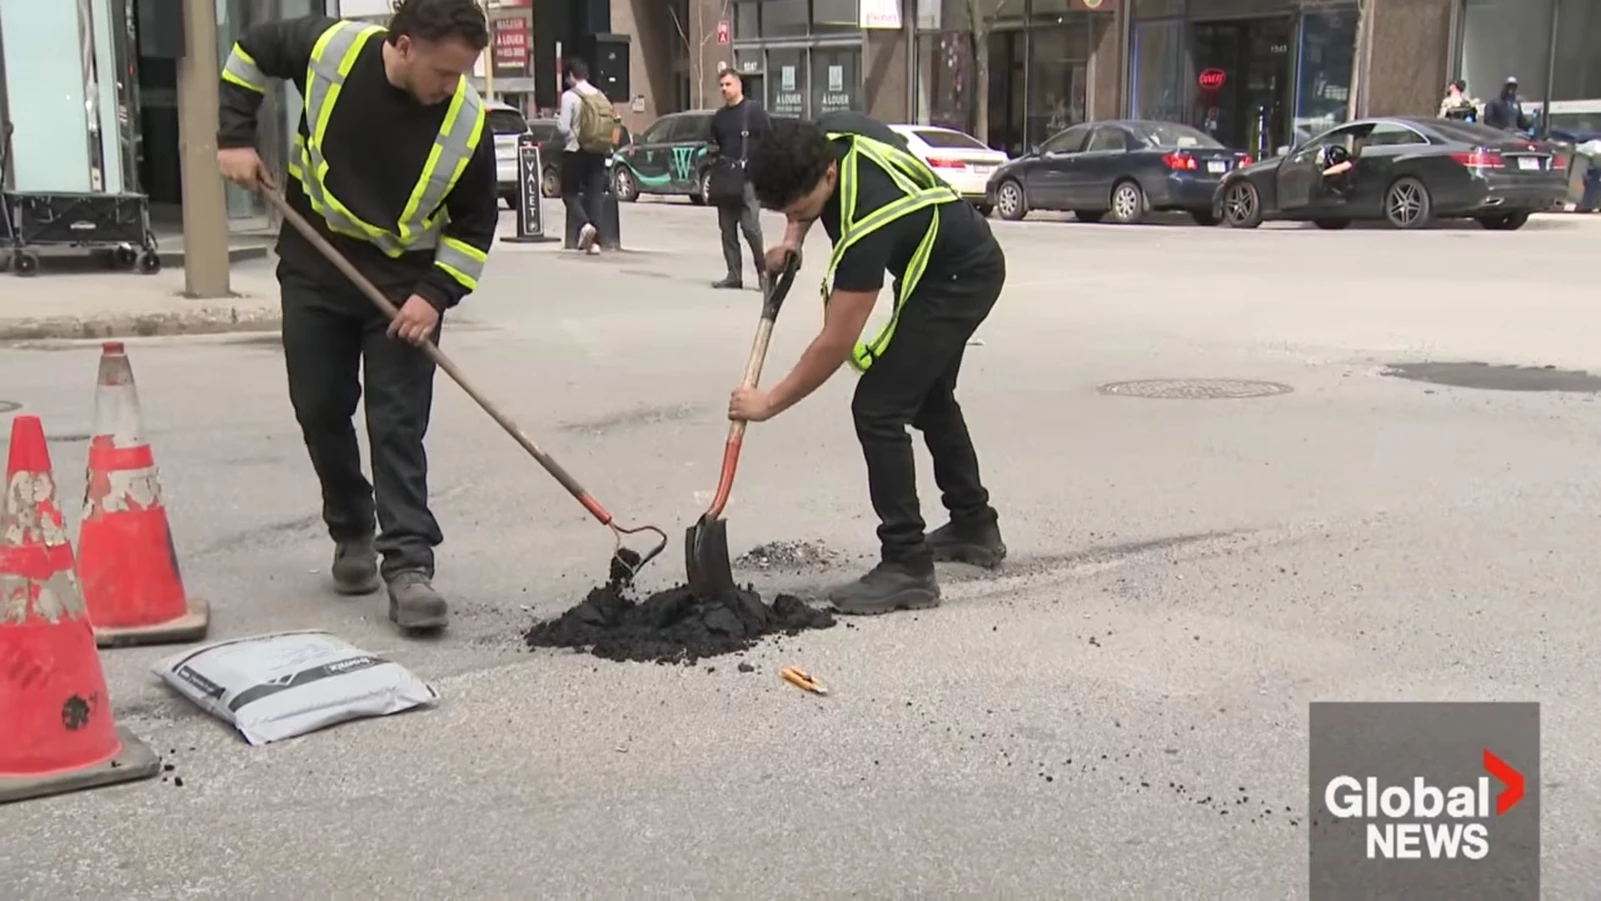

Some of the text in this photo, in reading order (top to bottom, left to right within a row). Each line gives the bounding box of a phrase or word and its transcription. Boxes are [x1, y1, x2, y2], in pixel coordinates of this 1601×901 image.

[503, 34, 524, 45] LOUER
[782, 94, 801, 104] LOUER
[829, 94, 849, 105] LOUER
[526, 161, 537, 217] VALET
